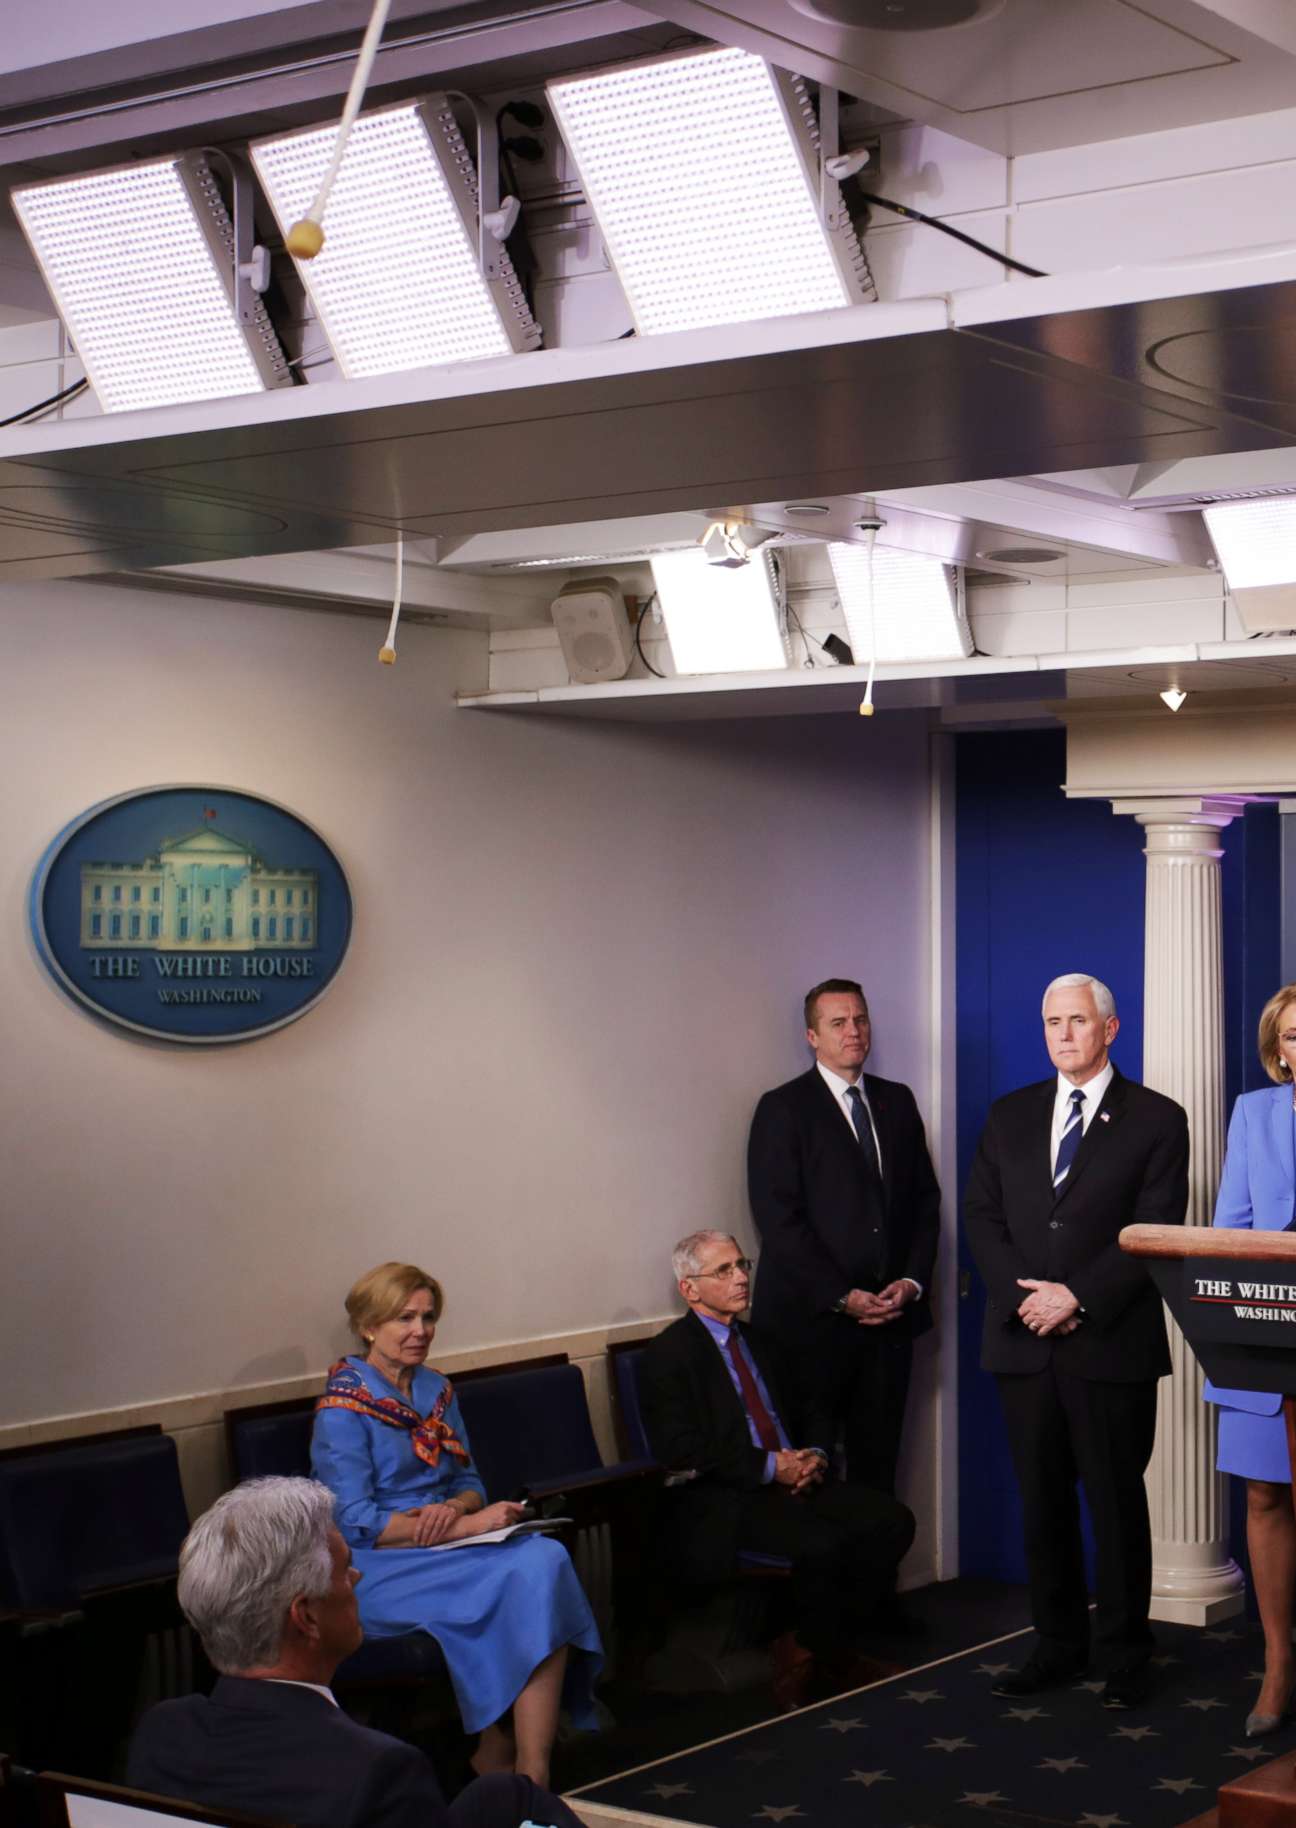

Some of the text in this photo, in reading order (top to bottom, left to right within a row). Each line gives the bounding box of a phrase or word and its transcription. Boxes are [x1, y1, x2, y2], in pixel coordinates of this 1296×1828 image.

[91, 956, 313, 977] THE WHITE HOUSE
[159, 987, 260, 1004] WASHINGTON
[1195, 1279, 1232, 1297] THE
